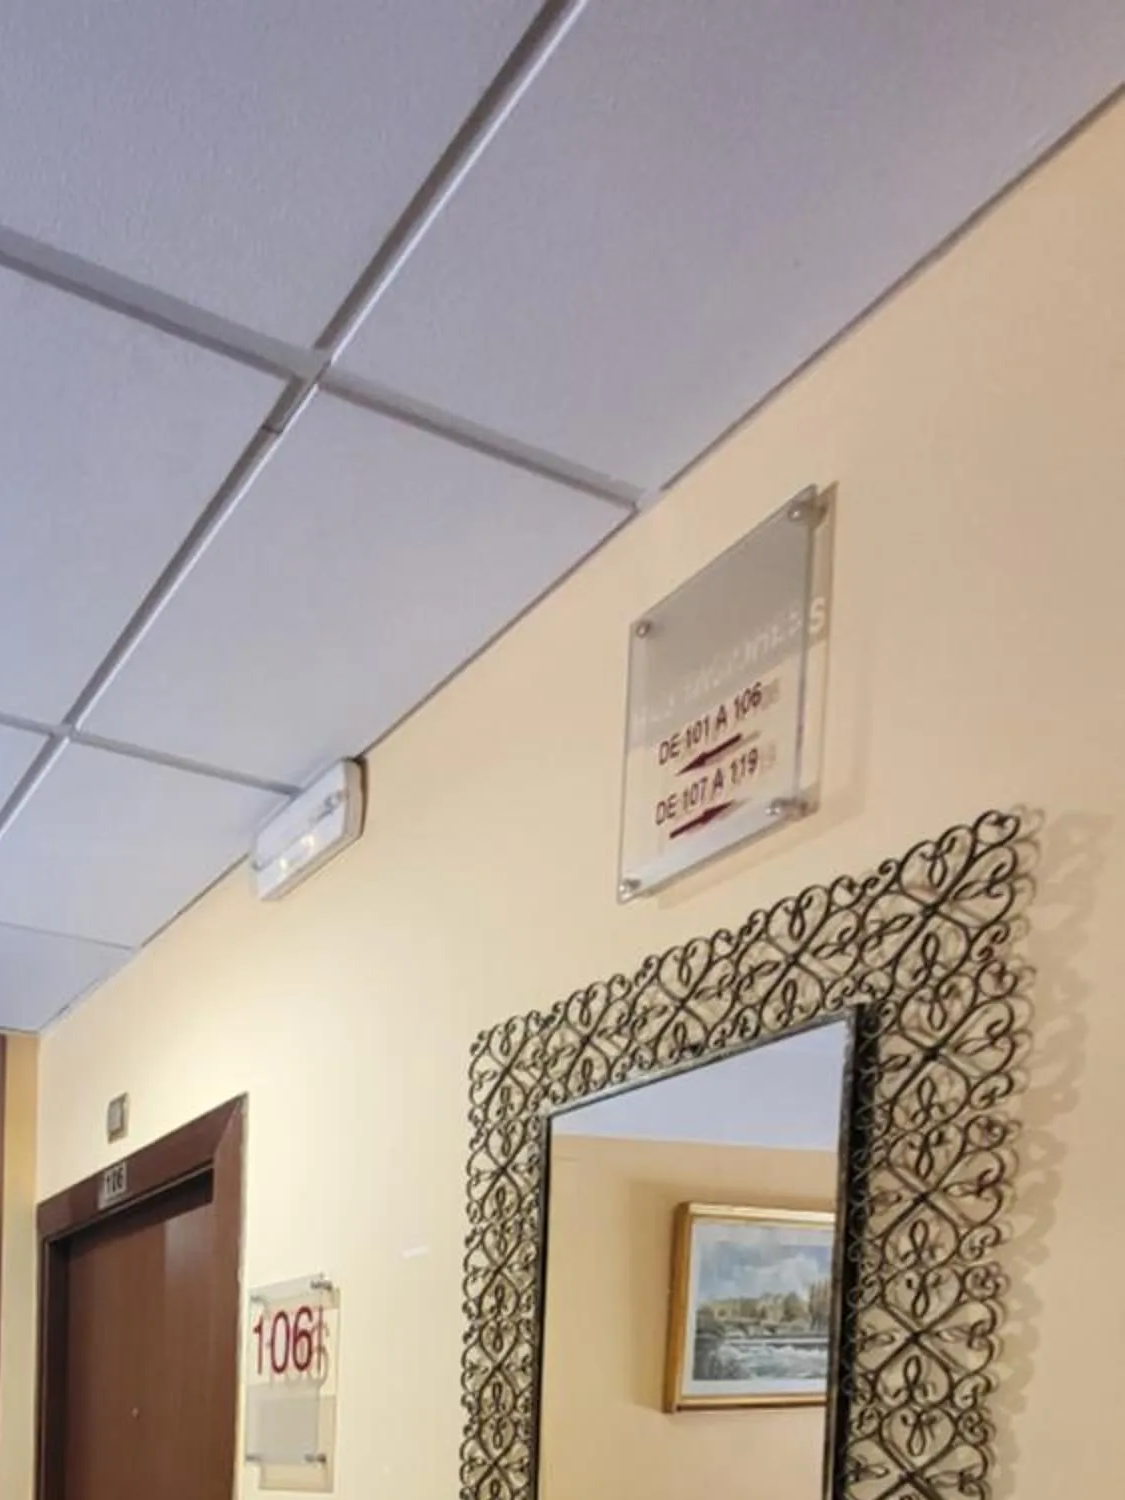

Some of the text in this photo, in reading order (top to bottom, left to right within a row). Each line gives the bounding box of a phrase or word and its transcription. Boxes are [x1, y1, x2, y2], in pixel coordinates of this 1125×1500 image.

[659, 681, 763, 765] DE 101 A 106
[655, 748, 759, 826] DE 107 A 119
[253, 1305, 313, 1375] 106
